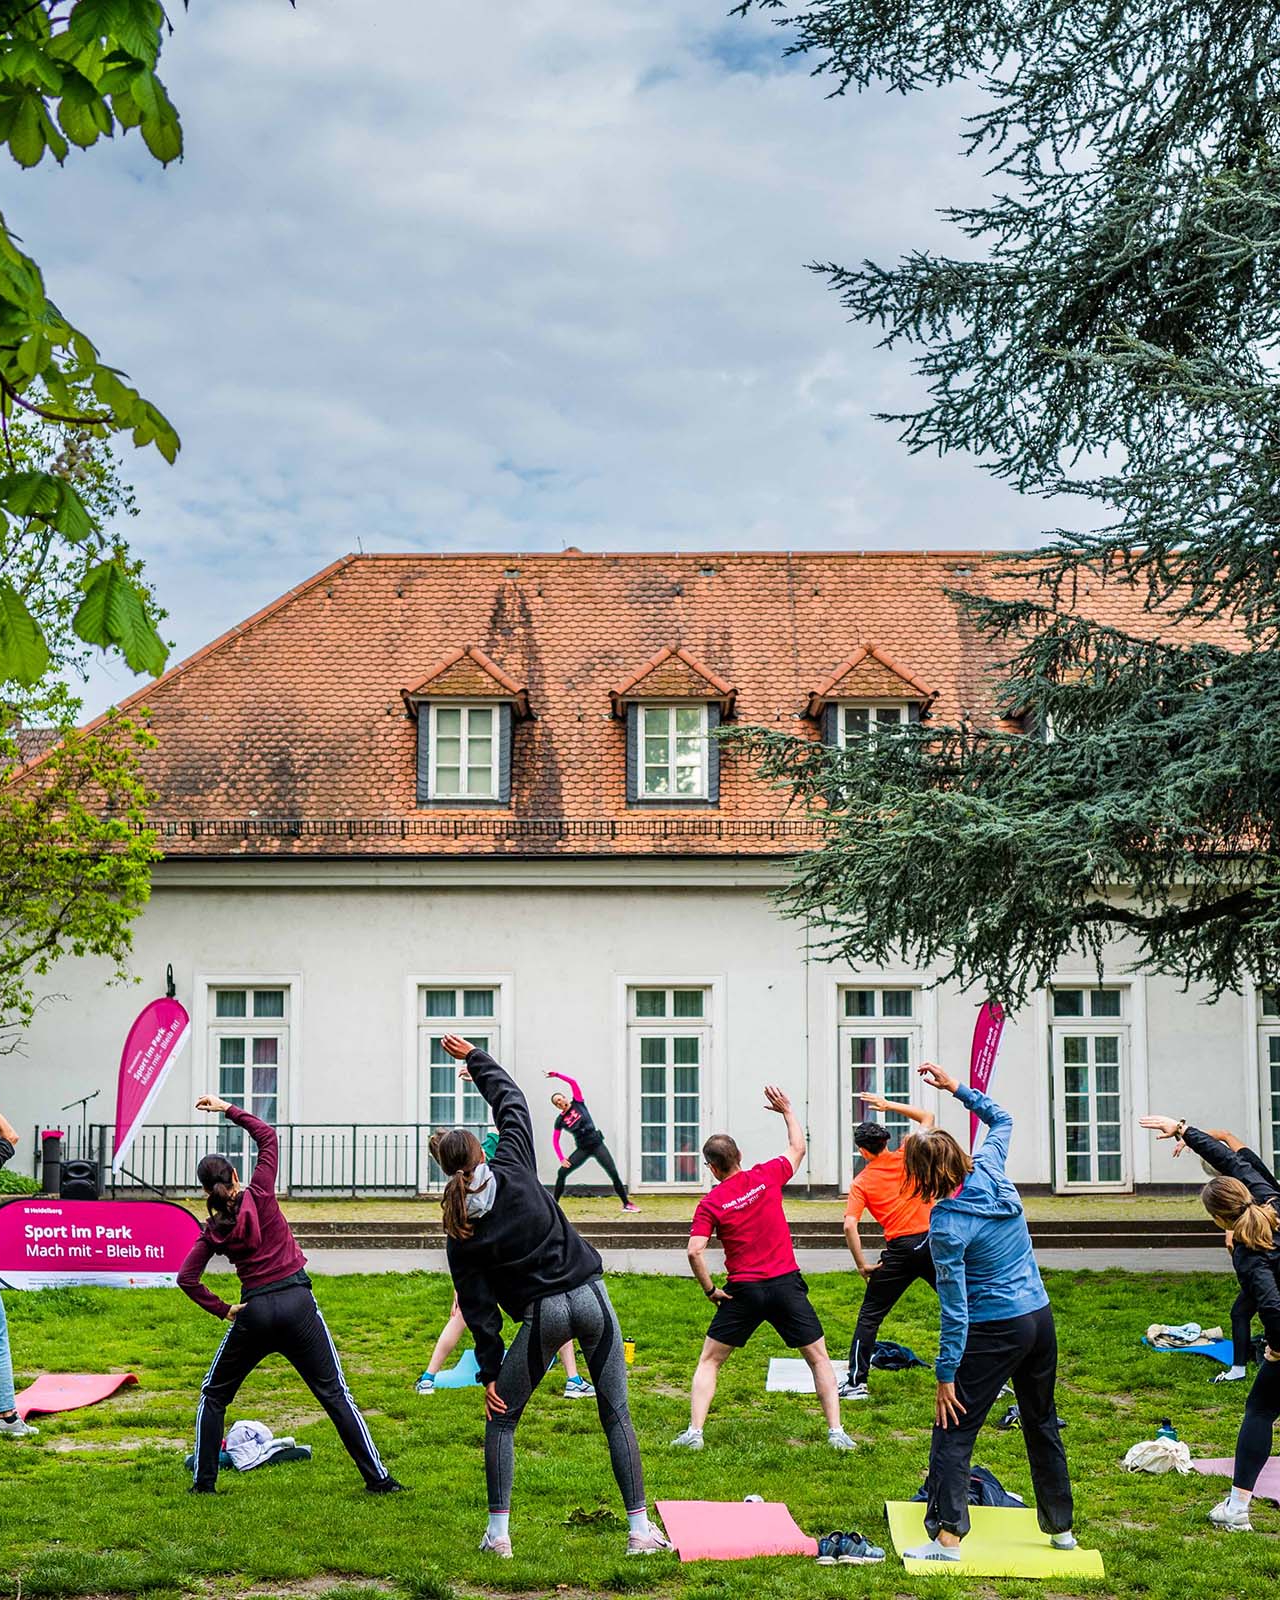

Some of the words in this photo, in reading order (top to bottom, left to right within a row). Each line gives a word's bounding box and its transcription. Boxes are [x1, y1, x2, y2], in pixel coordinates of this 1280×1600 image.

[133, 1058, 148, 1080] Sport
[145, 1046, 155, 1058] im
[152, 1027, 166, 1047] Park
[140, 1066, 154, 1085] Mach
[722, 1199, 737, 1210] Stadt
[736, 1184, 765, 1203] Heidelberg
[30, 1207, 63, 1216] Heidelberg
[24, 1224, 68, 1241] Sport
[71, 1225, 92, 1239] im
[95, 1225, 133, 1240] Park
[26, 1243, 65, 1257] Mach
[68, 1244, 92, 1257] mit
[106, 1245, 142, 1258] Bleib
[144, 1245, 165, 1259] fit!
